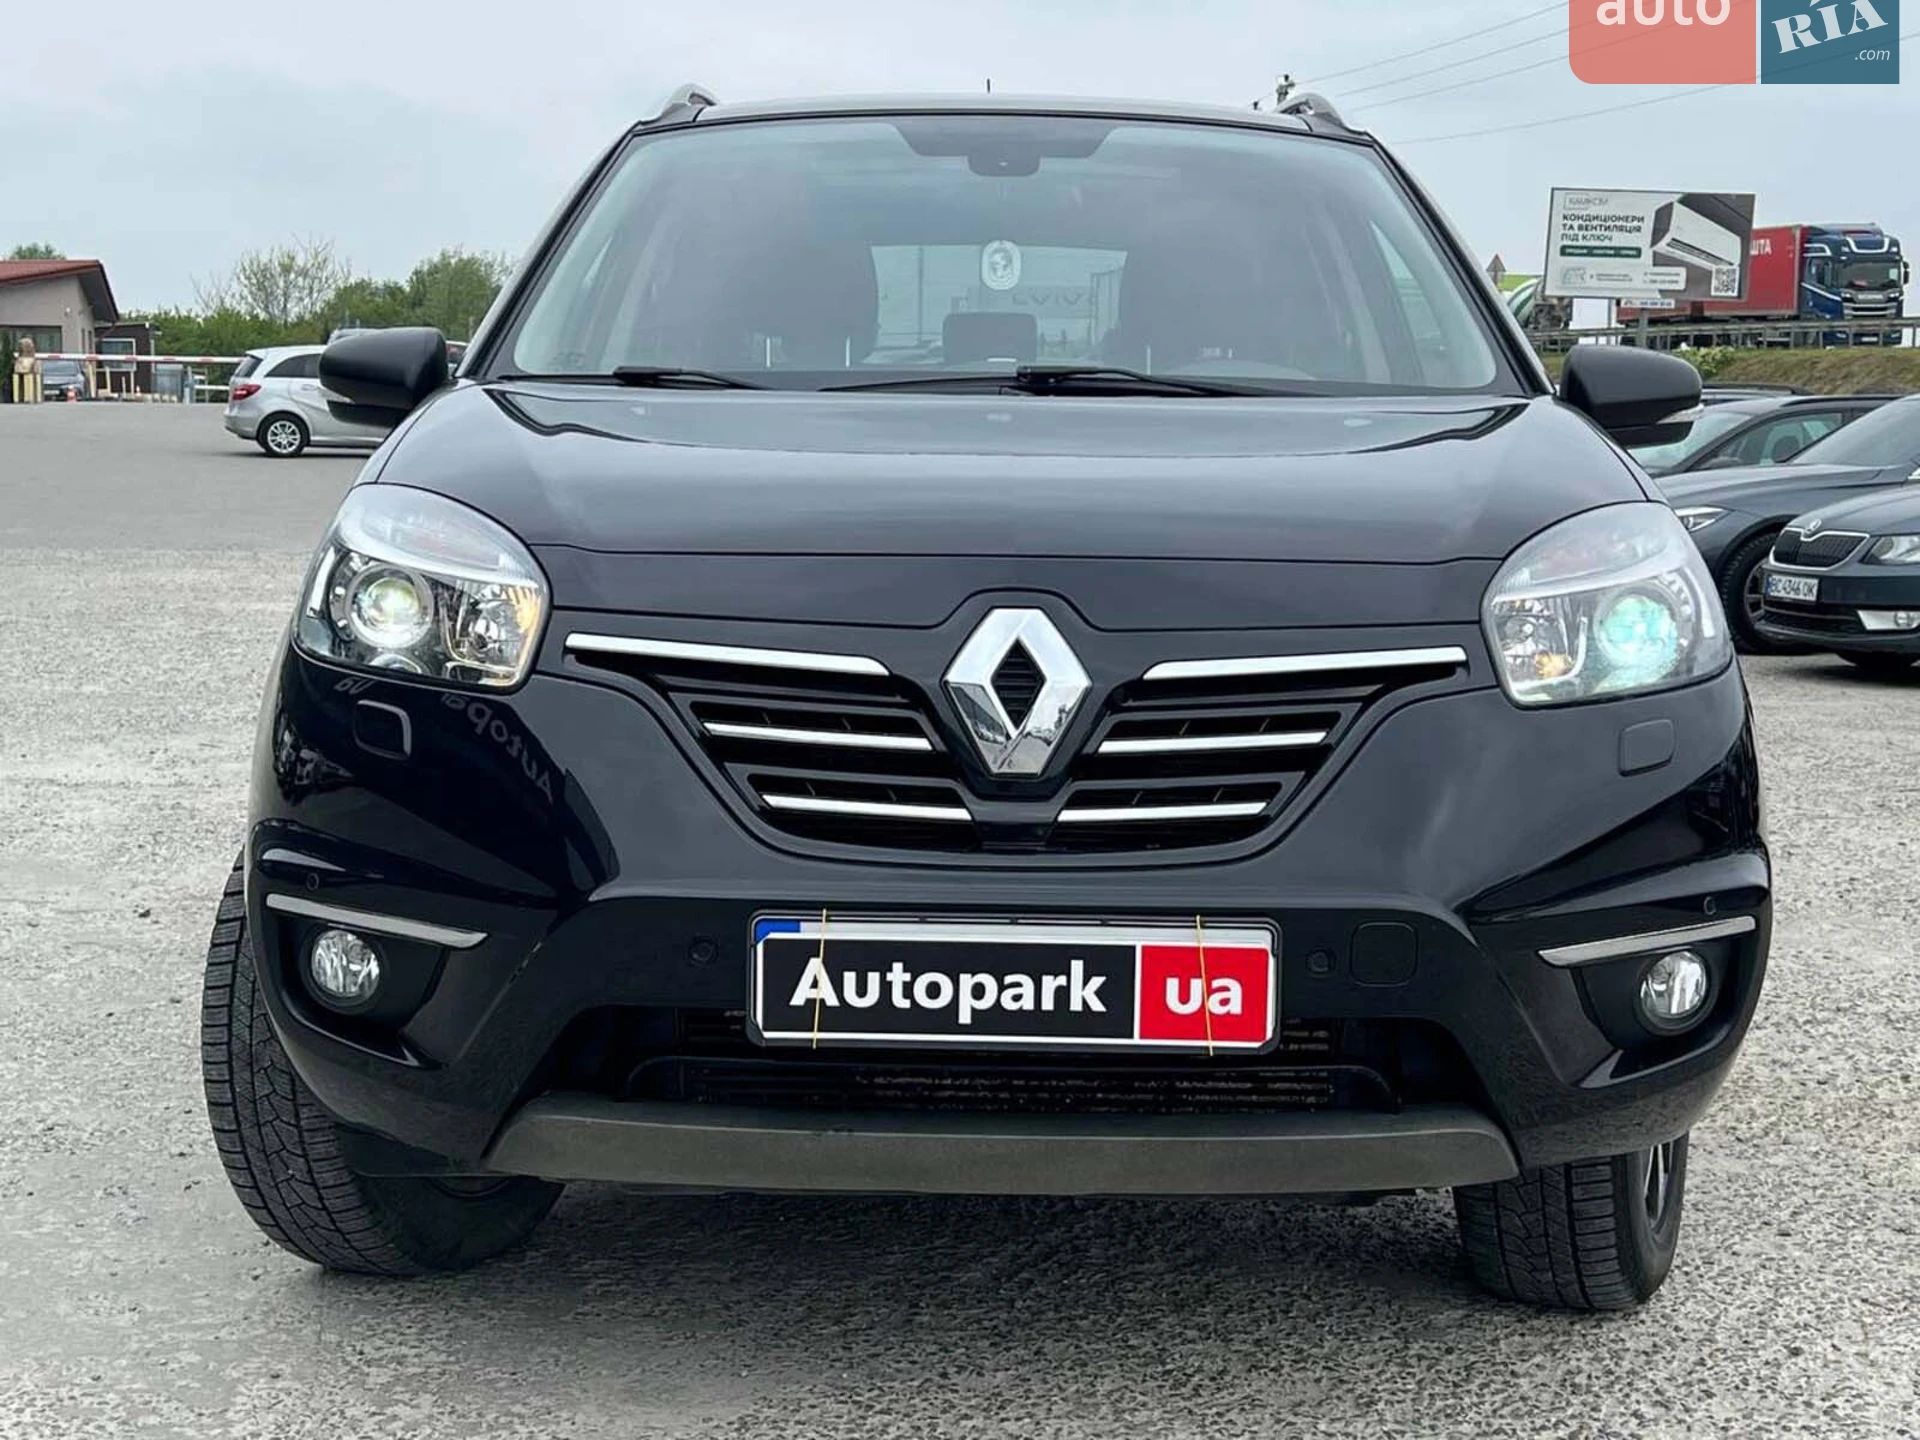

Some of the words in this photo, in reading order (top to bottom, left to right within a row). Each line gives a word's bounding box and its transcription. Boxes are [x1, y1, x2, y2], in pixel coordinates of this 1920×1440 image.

[1562, 213, 1645, 223] КОНДИЦІОНЕРИ
[1561, 223, 1576, 231] ТА
[1577, 224, 1642, 233] ВЕНТИЛЯЦІЯ
[1561, 233, 1579, 242] ПІД
[1582, 234, 1613, 242] КЛЮЧ
[789, 958, 1107, 1025] Autopark
[1164, 975, 1244, 1015] ua
